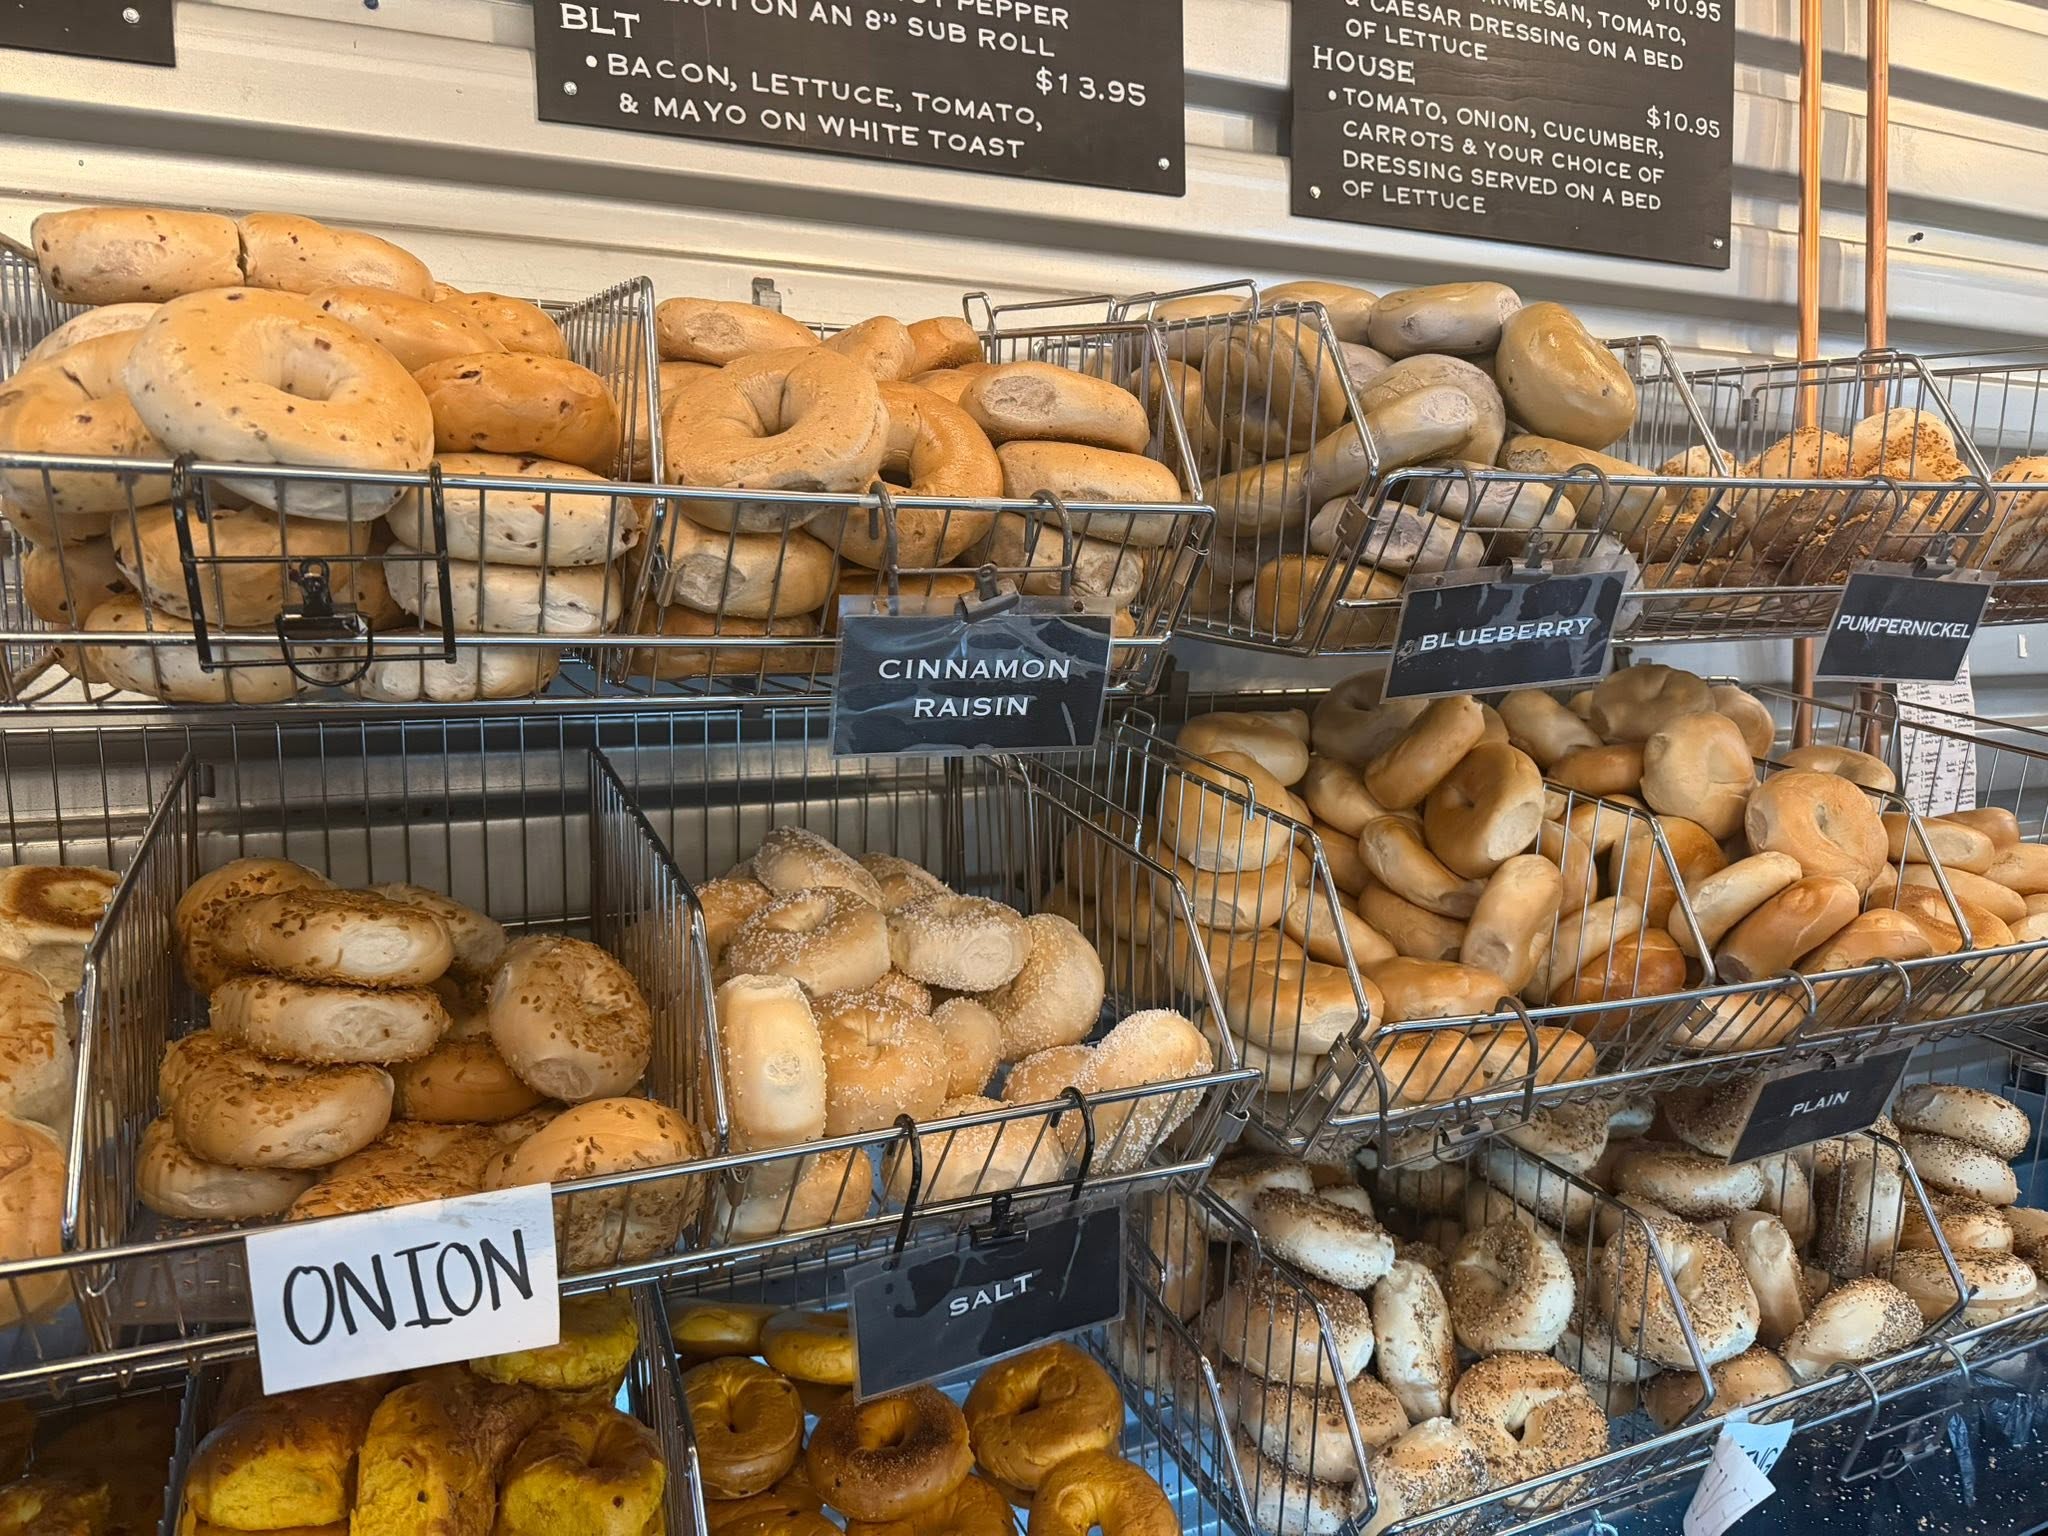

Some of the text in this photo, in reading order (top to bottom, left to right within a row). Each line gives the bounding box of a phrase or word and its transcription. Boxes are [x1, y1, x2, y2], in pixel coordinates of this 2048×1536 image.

[560, 2, 641, 39] BLT
[751, 0, 798, 19] ON
[809, 1, 853, 26] AN
[908, 17, 967, 43] SUB
[978, 28, 1055, 57] ROLL
[957, 0, 1069, 30] PEPPER
[1371, 0, 1683, 70] CAESAR DRESSING ON A BED
[1598, 11, 1687, 46] TOMATO,
[1345, 18, 1488, 61] OF LETTUCE
[1312, 45, 1416, 85] HOUSE
[607, 53, 1043, 132] BACON, LETTUCE, TOMATO,
[1036, 66, 1147, 107] $13.95
[619, 93, 1024, 159] & MAYO ON WHITE TOAST
[1343, 87, 1665, 159] TOMATO, ONION, CUCUMBER,
[1646, 105, 1720, 138] $10.95
[1343, 120, 1665, 184] CARROTS & YOUR CHOICE OF
[1342, 180, 1486, 214] OF LETTUCE
[1343, 149, 1661, 210] DRESSING SERVED ON A BED
[1420, 617, 1594, 651] BLUEBERRY
[1836, 615, 1971, 639] PUMPERNICKEL
[878, 659, 1071, 679] CINNAMON
[914, 697, 1029, 718] RAISIN
[1789, 1091, 1851, 1117] PLAIN
[283, 1229, 533, 1345] ONION
[949, 1272, 1033, 1317] SALT
